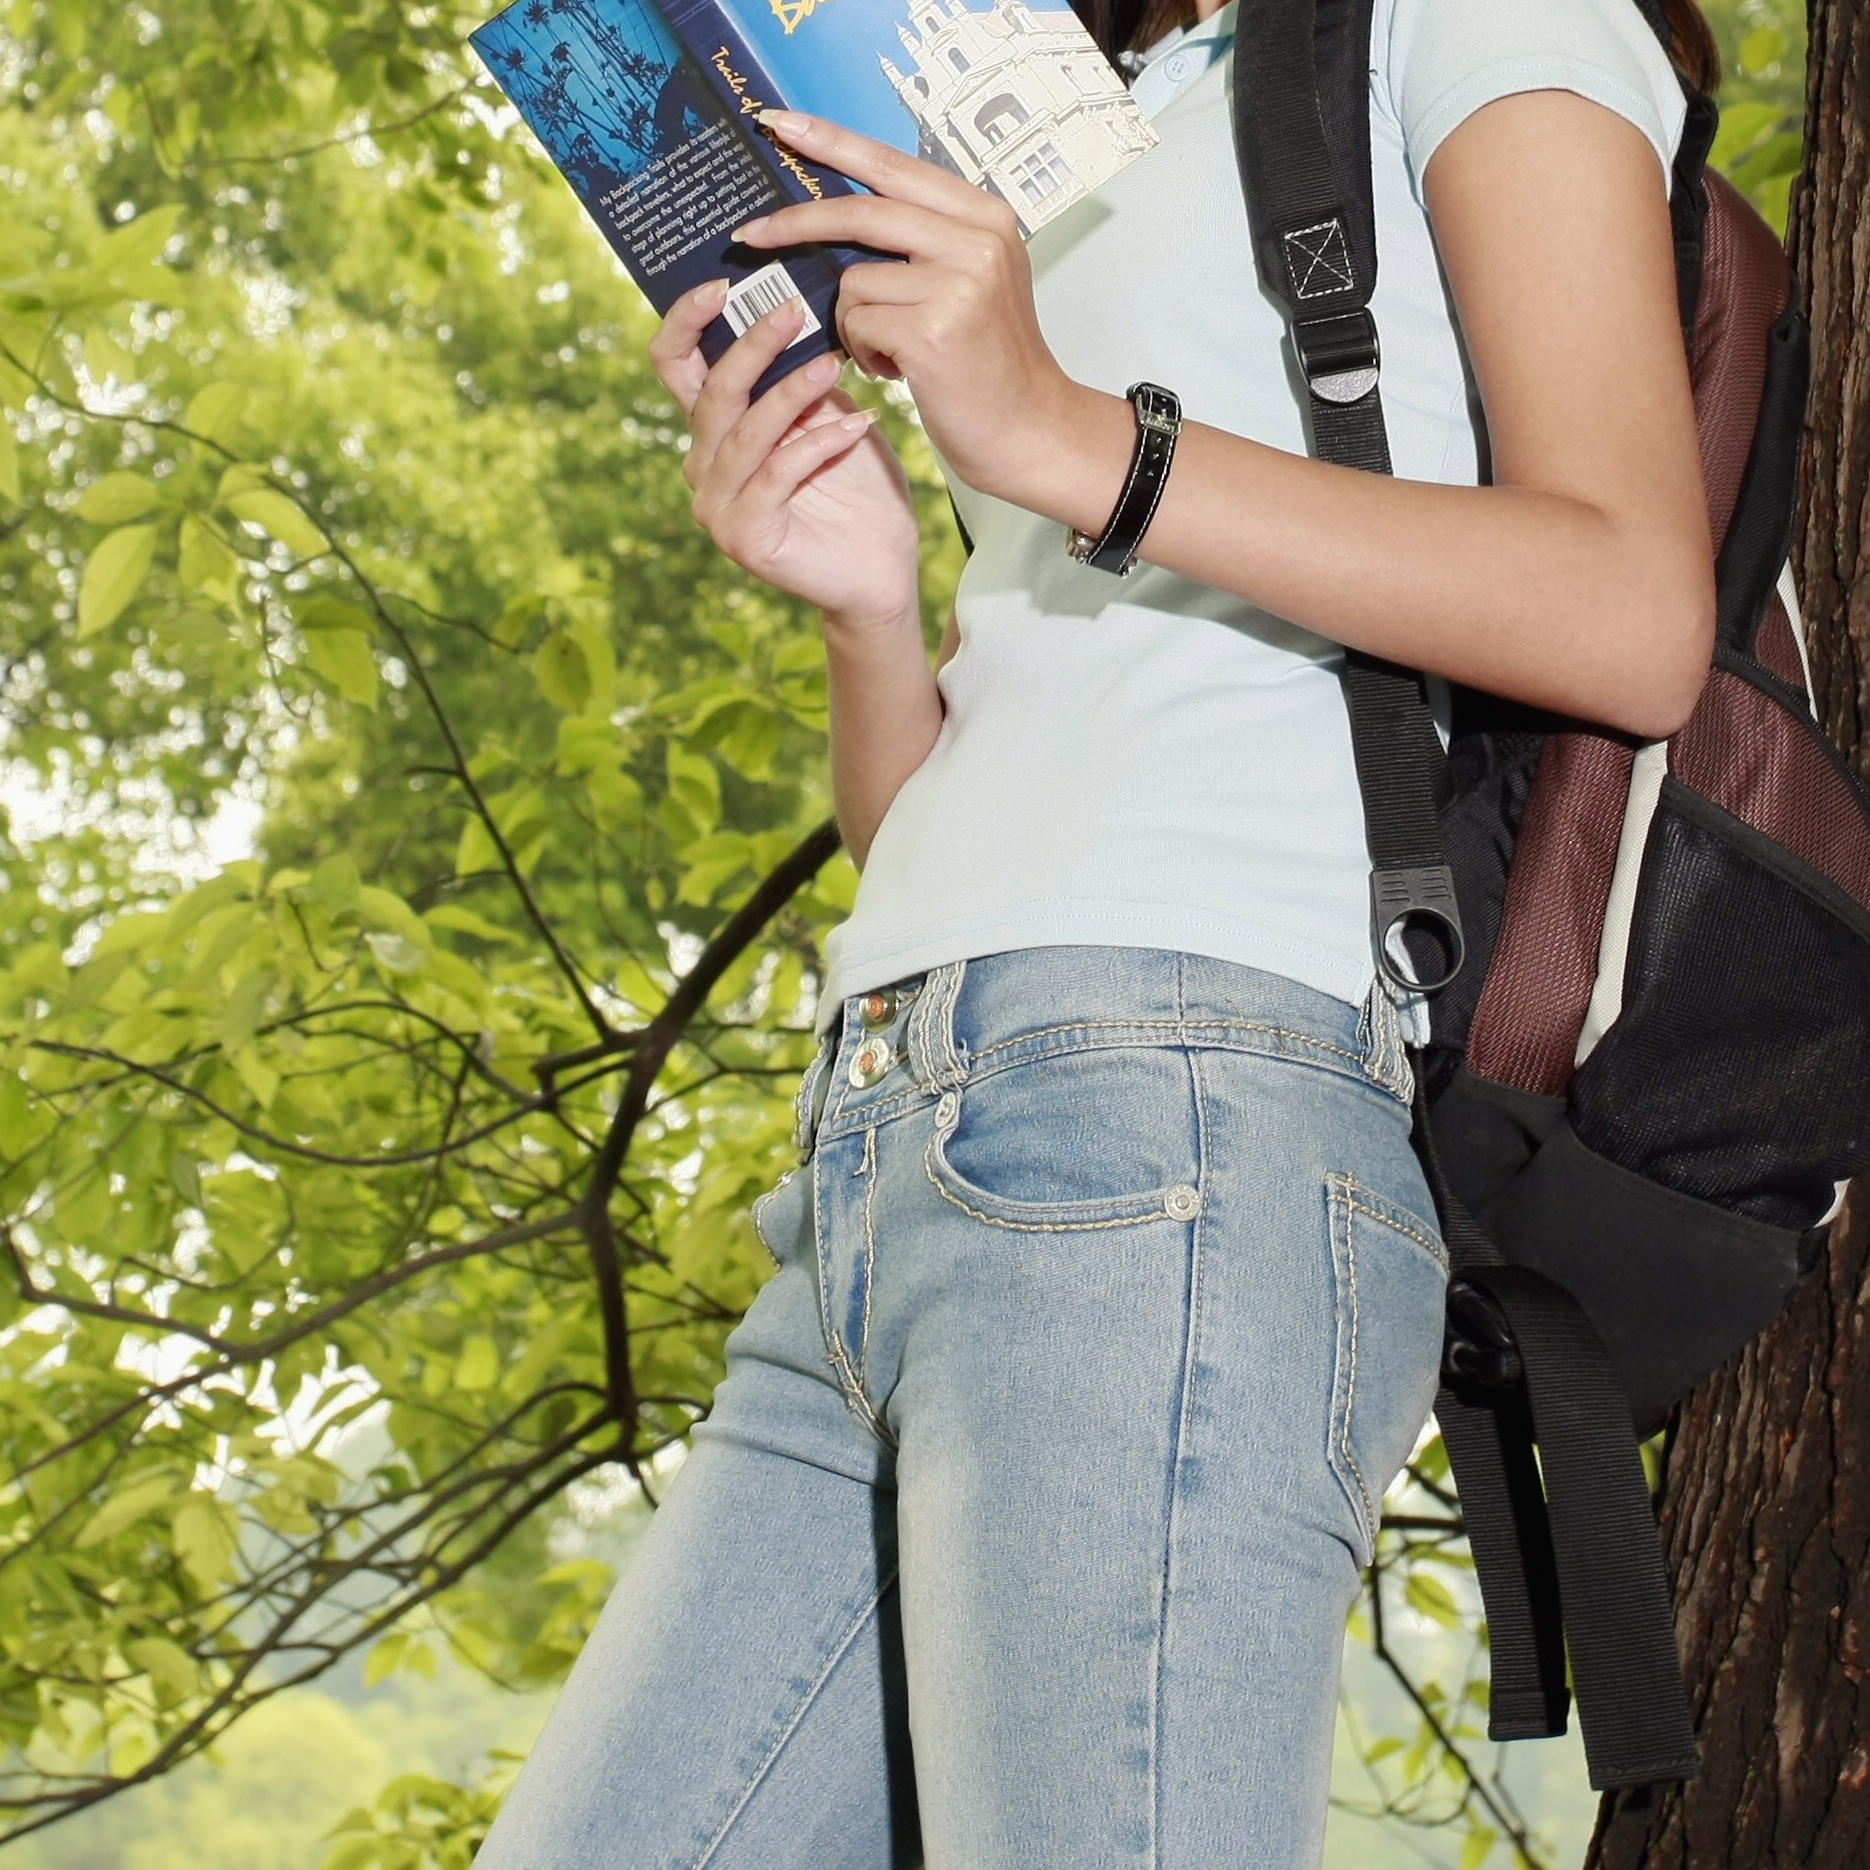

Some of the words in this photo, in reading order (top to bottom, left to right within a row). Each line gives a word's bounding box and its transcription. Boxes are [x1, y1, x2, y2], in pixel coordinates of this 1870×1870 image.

[711, 46, 747, 95] Trails
[740, 96, 763, 114] of
[599, 195, 613, 207] My
[609, 171, 650, 200] Backpacking
[664, 143, 691, 166] provides
[696, 124, 719, 142] readers
[608, 211, 615, 219] a
[615, 191, 640, 214] detailed
[640, 175, 669, 197] narration
[668, 165, 677, 178] of
[676, 162, 689, 172] the
[688, 147, 711, 165] various
[614, 205, 645, 230] backpack
[670, 178, 687, 193] what
[684, 175, 694, 184] to
[693, 161, 713, 179] expect
[711, 152, 725, 167] and
[722, 149, 734, 159] the
[622, 233, 632, 242] to
[631, 214, 661, 237] overcome
[660, 206, 673, 217] the
[710, 169, 730, 183] From
[727, 162, 740, 172] the
[631, 239, 648, 254] stage
[647, 230, 656, 243] of
[654, 216, 684, 240] planning
[682, 204, 698, 220] right
[697, 200, 708, 210] up
[706, 195, 716, 203] to
[714, 182, 737, 199] setting
[732, 172, 748, 186] foot
[744, 169, 754, 178] in
[638, 250, 655, 268] great
[682, 224, 696, 236] this
[695, 204, 723, 228] essential
[722, 194, 741, 213] guide
[739, 183, 760, 200] covers
[645, 258, 668, 276] through
[665, 253, 678, 264] the
[676, 236, 704, 257] narration
[702, 228, 712, 241] of
[710, 227, 717, 236] a
[714, 206, 749, 232] backpacker
[746, 203, 756, 211] in
